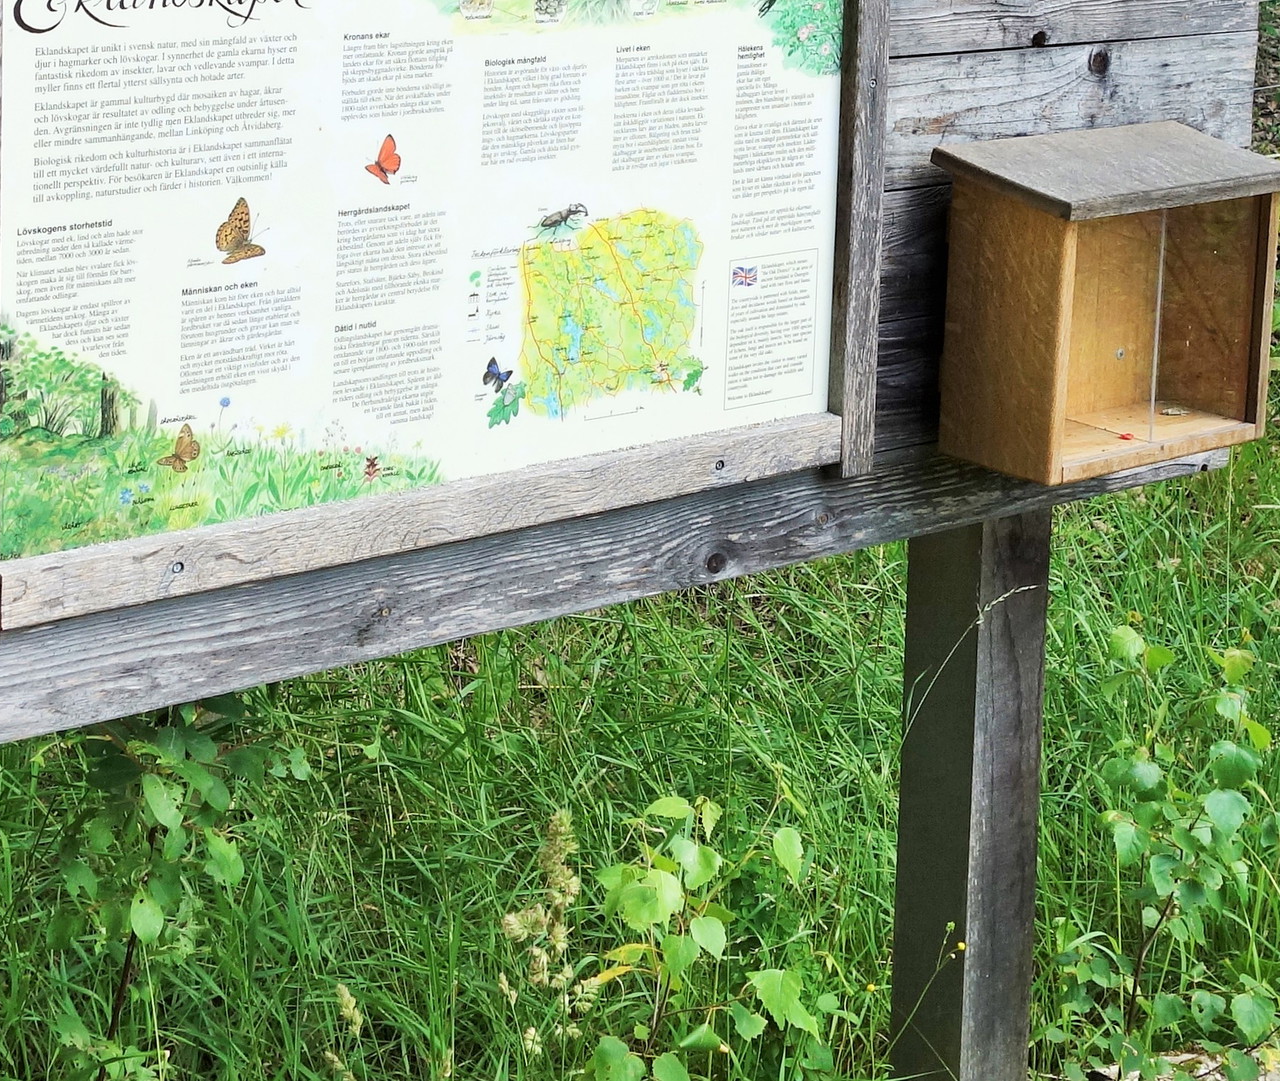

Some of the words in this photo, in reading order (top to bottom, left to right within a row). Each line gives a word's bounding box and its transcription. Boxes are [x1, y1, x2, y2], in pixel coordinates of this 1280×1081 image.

[35, 44, 88, 58] Eklandskapet
[91, 43, 99, 52] är
[101, 42, 121, 52] unikt
[124, 41, 126, 50] i
[129, 40, 154, 50] svensk
[157, 40, 178, 50] natur,
[181, 37, 196, 47] med
[199, 36, 209, 46] sin
[212, 34, 246, 48] mångfald
[260, 32, 282, 43] växter
[283, 31, 297, 41] och
[343, 33, 373, 41] Kronans
[34, 59, 51, 71] djur
[53, 58, 56, 67] i
[59, 56, 101, 70] hagmarker
[103, 55, 117, 64] och
[120, 52, 159, 66] lövskogar.
[162, 52, 164, 61] I
[167, 49, 203, 63] synnerhet
[206, 49, 214, 58] de
[217, 47, 239, 60] gamla
[241, 45, 265, 56] ekarna
[267, 44, 287, 57] hyser
[485, 58, 515, 67] Biologisk
[517, 56, 546, 65] mångfald
[738, 52, 765, 60] hemlighet
[35, 69, 72, 80] fantastisk
[75, 67, 108, 78] rikedom
[110, 68, 119, 76] av
[122, 64, 154, 76] insekter,
[157, 63, 176, 73] lavar
[177, 62, 191, 71] och
[194, 59, 235, 70] vedlevande
[238, 59, 269, 70] svampar.
[272, 56, 274, 65] I
[277, 55, 294, 65] detta
[35, 82, 61, 95] myller
[63, 81, 83, 91] finns
[85, 81, 95, 89] ett
[98, 78, 120, 89] flertal
[123, 78, 147, 90] ytterst
[149, 74, 182, 88] sällsynta
[184, 73, 198, 83] och
[200, 71, 224, 82] hotade
[227, 71, 244, 80] arter.
[338, 203, 410, 217] Herrgårdslandskapet
[17, 224, 67, 236] Lövskogens
[69, 219, 113, 231] storhetstid
[181, 285, 222, 296] Människan
[224, 283, 238, 291] och
[240, 281, 258, 289] eken
[334, 323, 353, 333] Dåtid
[358, 321, 376, 330] nutid
